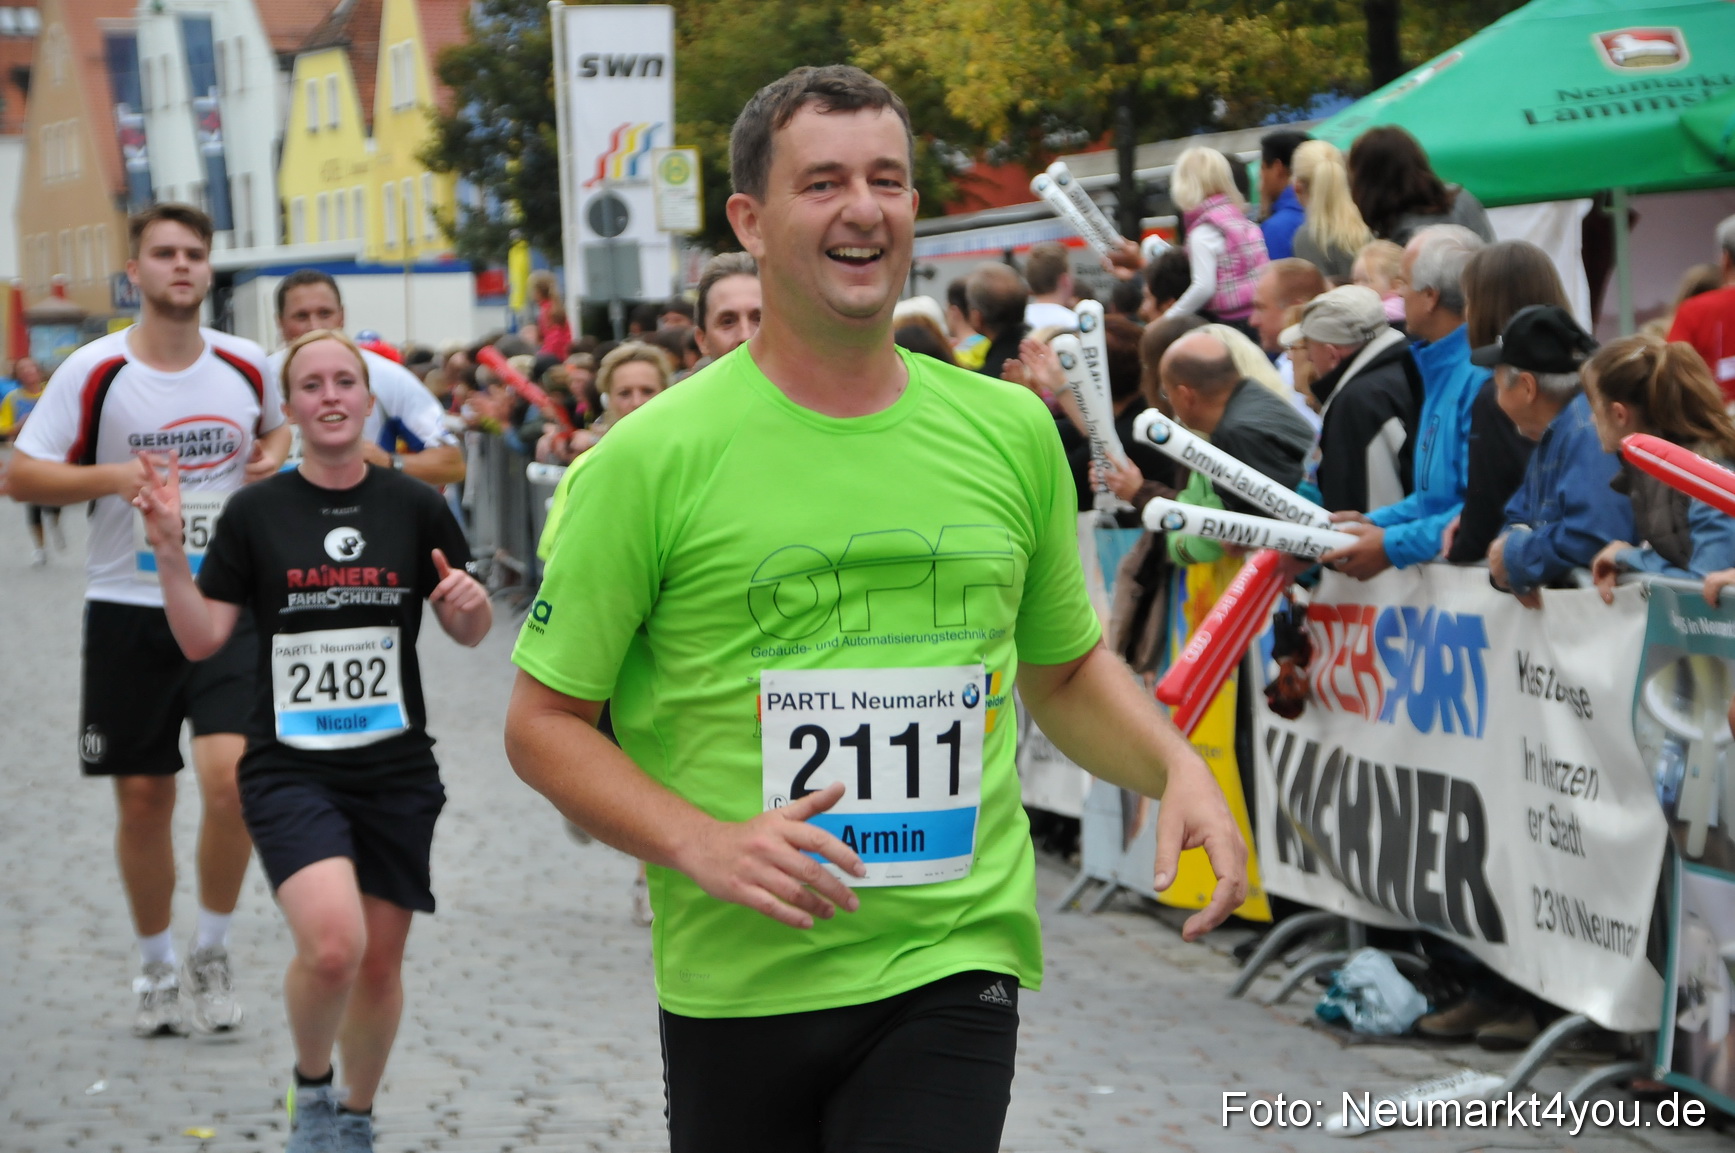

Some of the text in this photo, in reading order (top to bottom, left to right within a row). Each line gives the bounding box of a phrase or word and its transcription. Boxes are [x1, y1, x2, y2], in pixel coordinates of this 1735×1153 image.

[577, 52, 665, 78] swn
[128, 428, 224, 447] GERHART
[177, 441, 235, 457] JANIG
[1200, 517, 1261, 545] BMW
[275, 640, 376, 658] PARTL Neumarkt
[750, 638, 812, 659] Gebäude-
[815, 632, 840, 651] und
[841, 626, 988, 648] Automatisierungstechnik
[288, 656, 388, 704] 2482
[767, 690, 955, 711] PARTL Neumarkt
[316, 713, 368, 732] Nicole
[789, 719, 961, 800] 2111
[841, 823, 926, 855] Armin
[1547, 803, 1587, 859] Stadt
[979, 993, 1013, 1008] adidas
